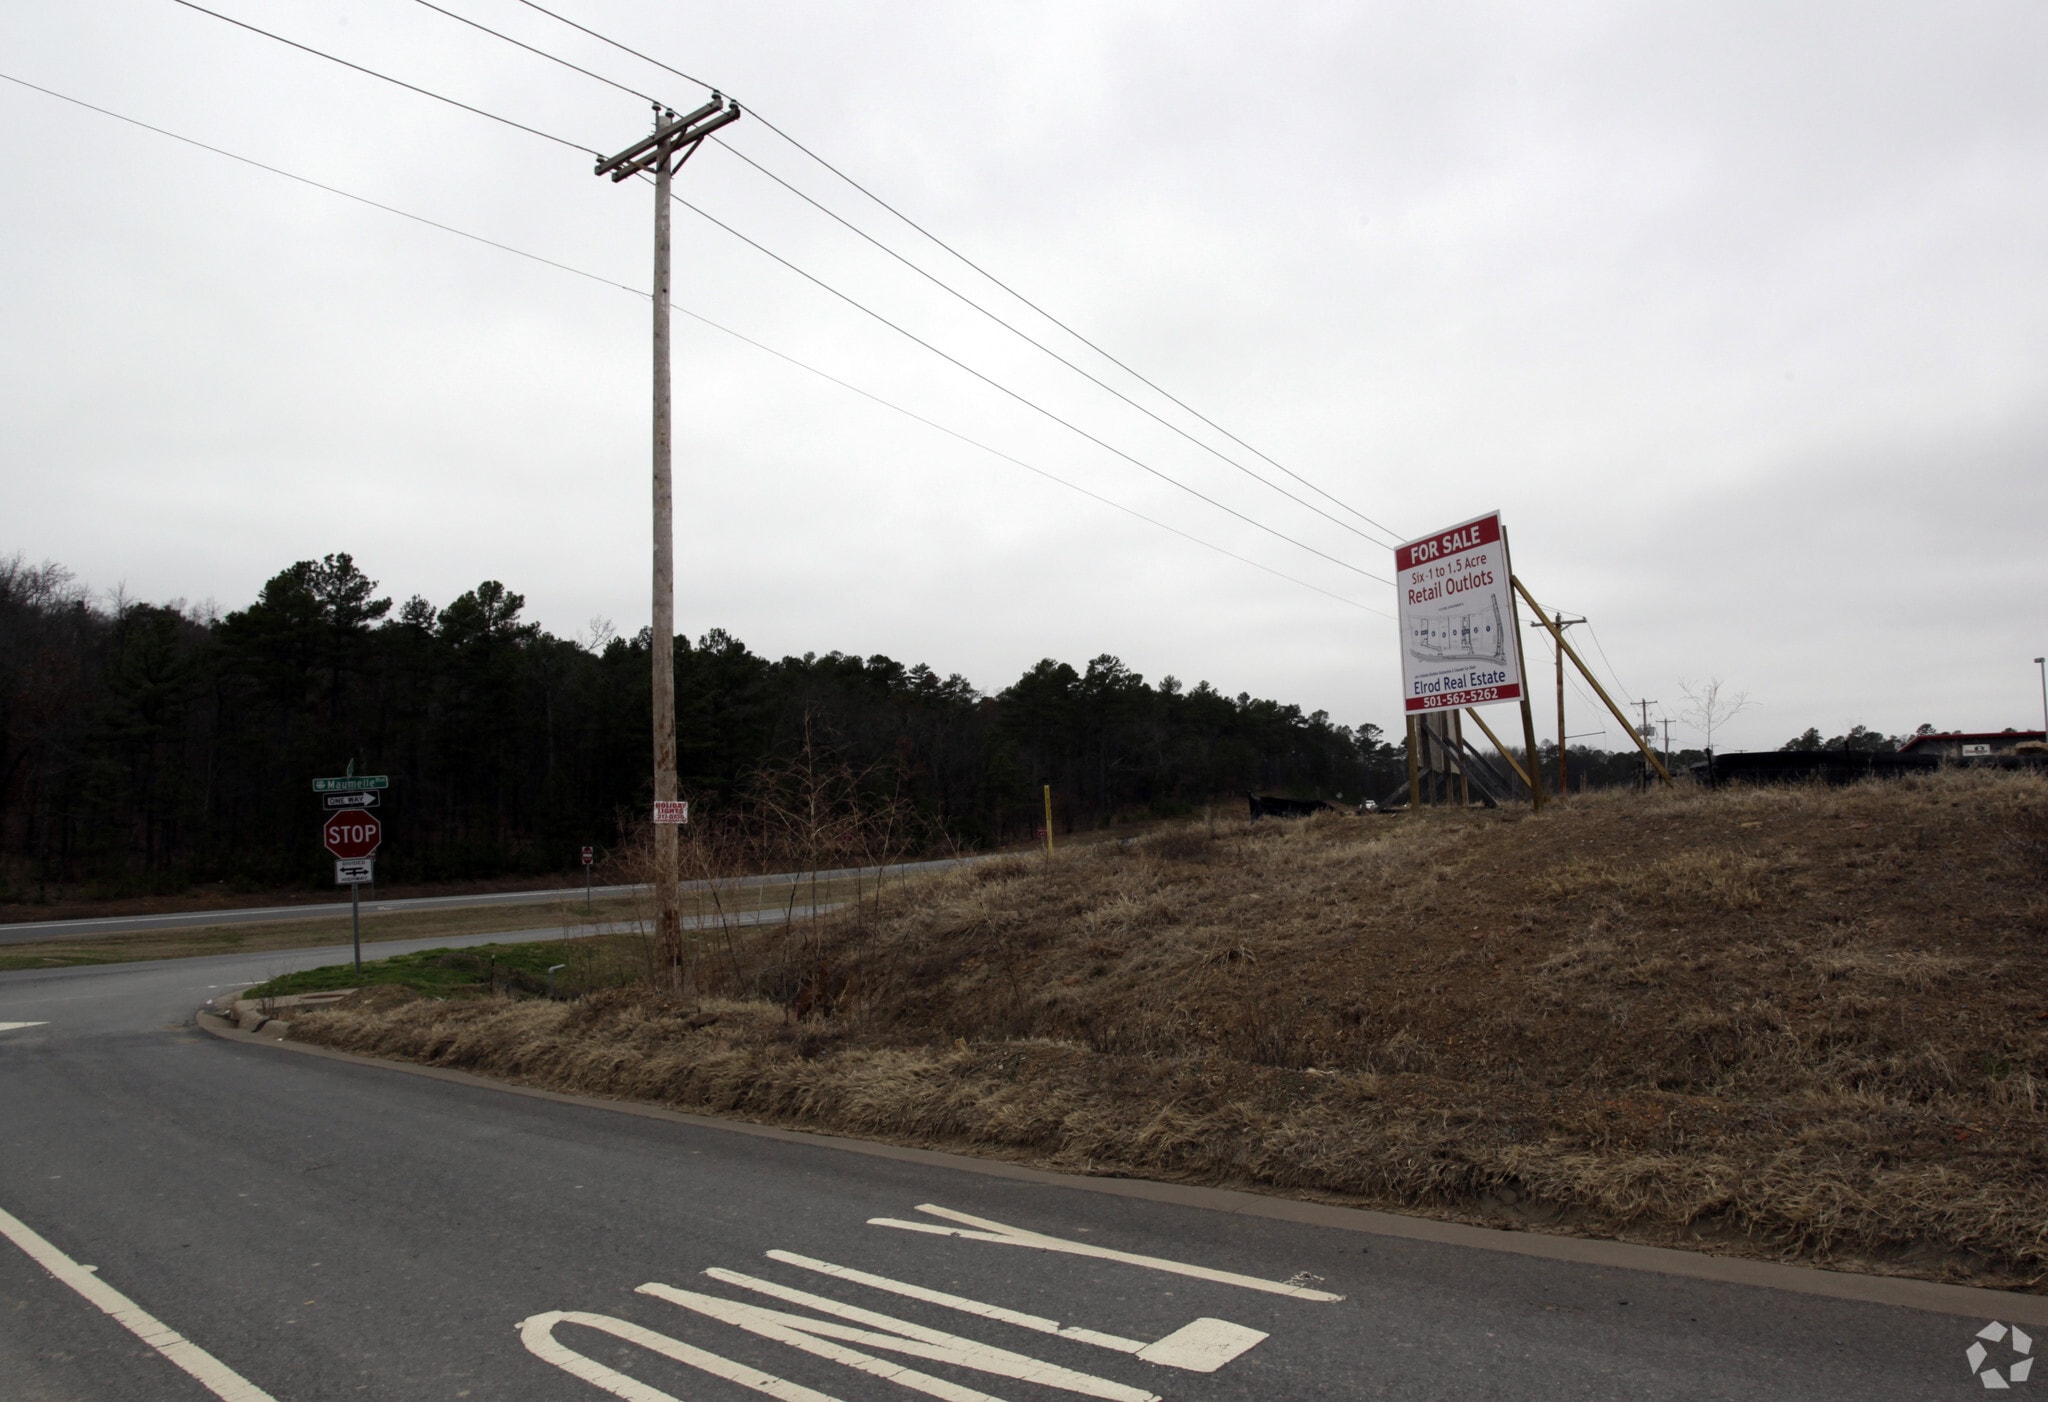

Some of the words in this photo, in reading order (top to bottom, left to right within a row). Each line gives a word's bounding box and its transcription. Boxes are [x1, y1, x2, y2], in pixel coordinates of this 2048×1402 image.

[1411, 541, 1439, 565] FOR
[1442, 526, 1480, 553] SALE
[1435, 567, 1445, 578] to
[1447, 559, 1462, 574] 1.5
[1465, 554, 1487, 570] Acre
[1408, 581, 1442, 605] Retail
[1446, 570, 1494, 595] Outlots
[1414, 678, 1441, 695] Elrod
[1444, 674, 1467, 690] Real
[1470, 670, 1506, 687] Estate
[1423, 687, 1498, 708] 501-562-5262
[327, 779, 375, 789] Maumelle
[329, 797, 345, 805] ONE
[329, 825, 377, 844] STOP
